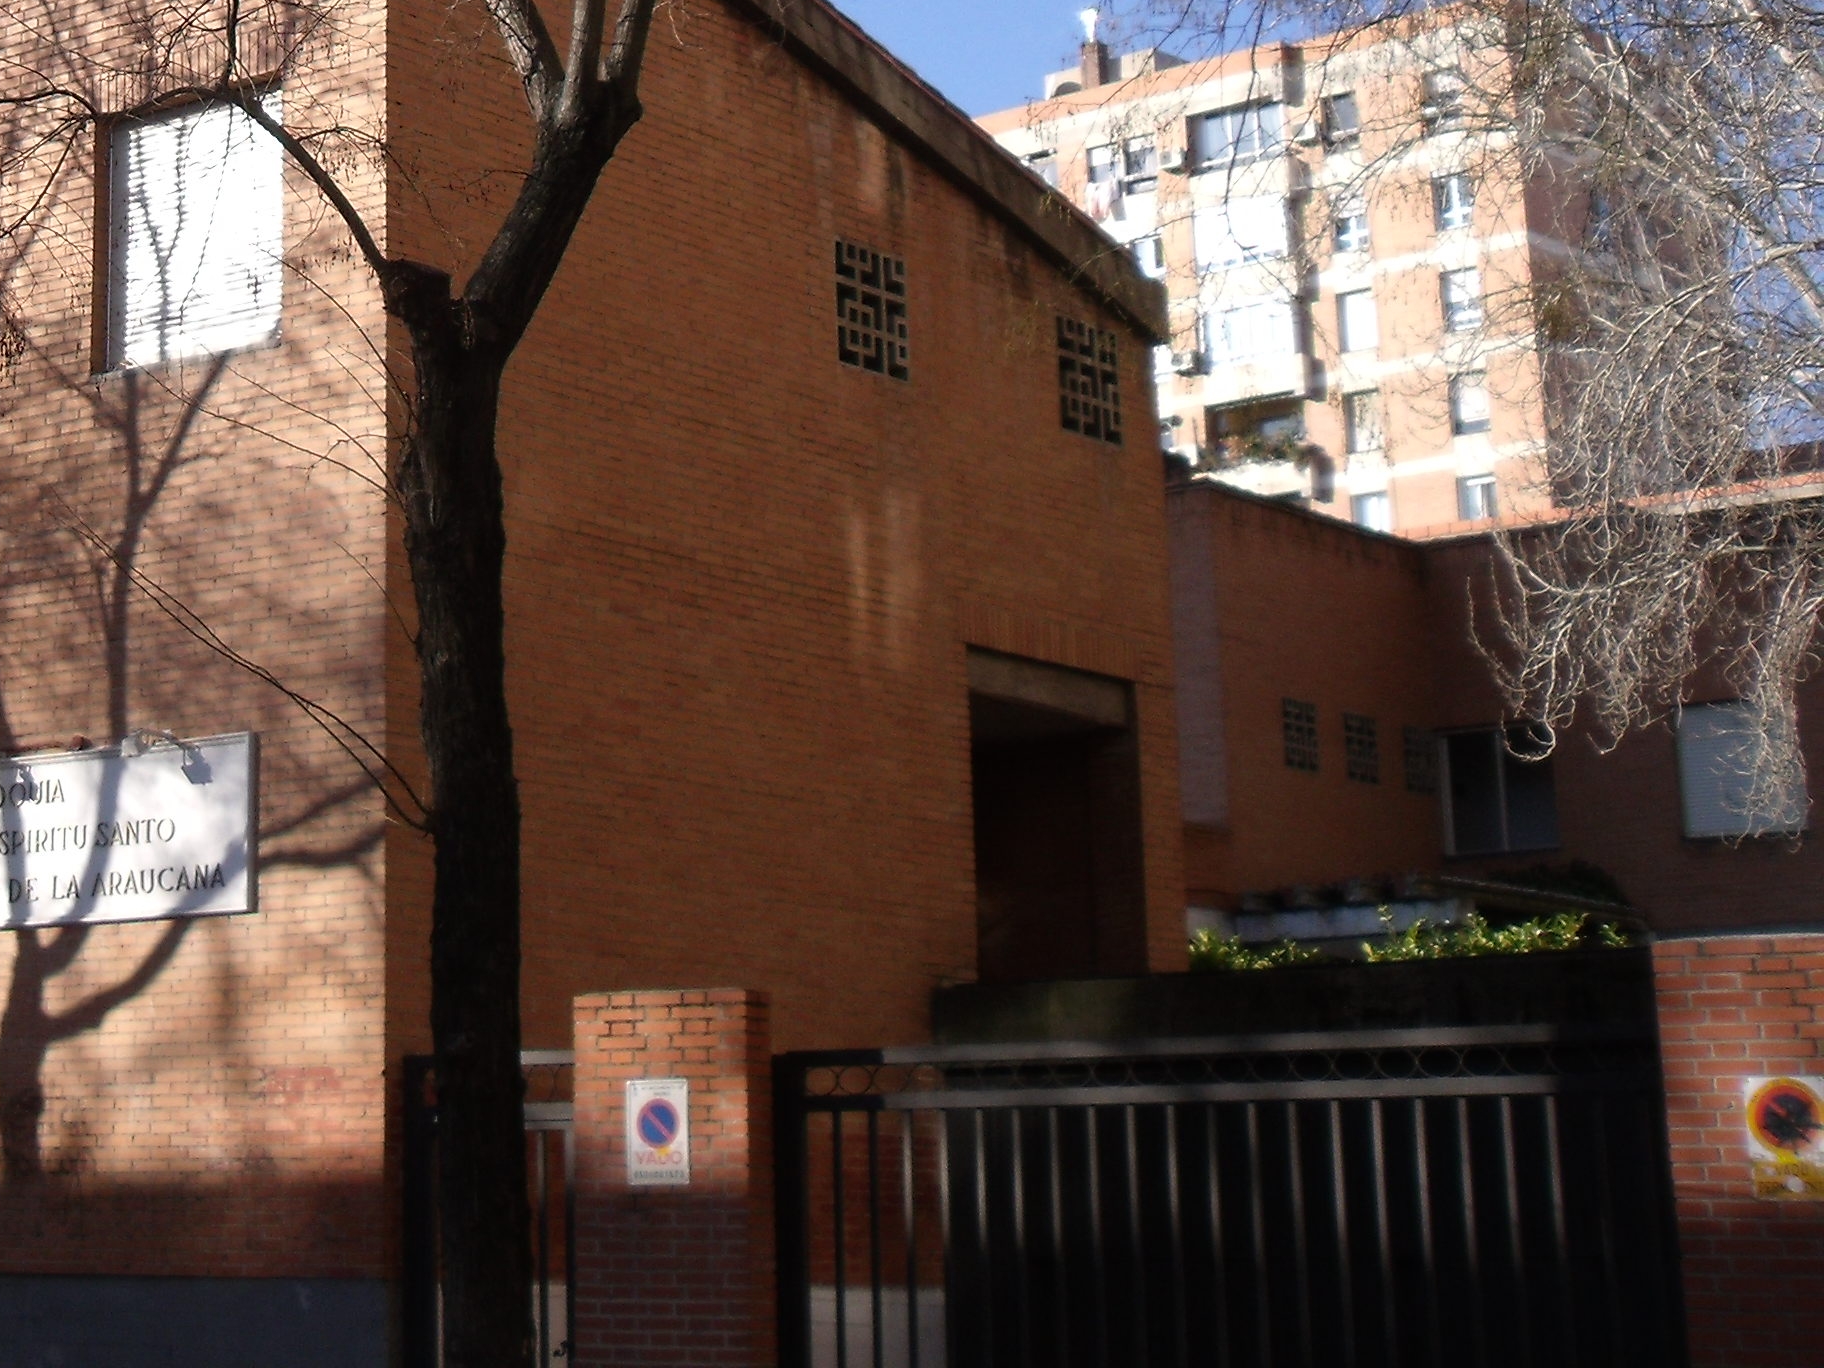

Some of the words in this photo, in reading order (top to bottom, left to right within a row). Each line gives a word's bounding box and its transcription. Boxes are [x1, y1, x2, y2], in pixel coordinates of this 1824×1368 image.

[94, 818, 176, 848] SANTO
[9, 878, 40, 903] DE
[52, 875, 80, 899] LA
[92, 863, 226, 897] ARAUCANA
